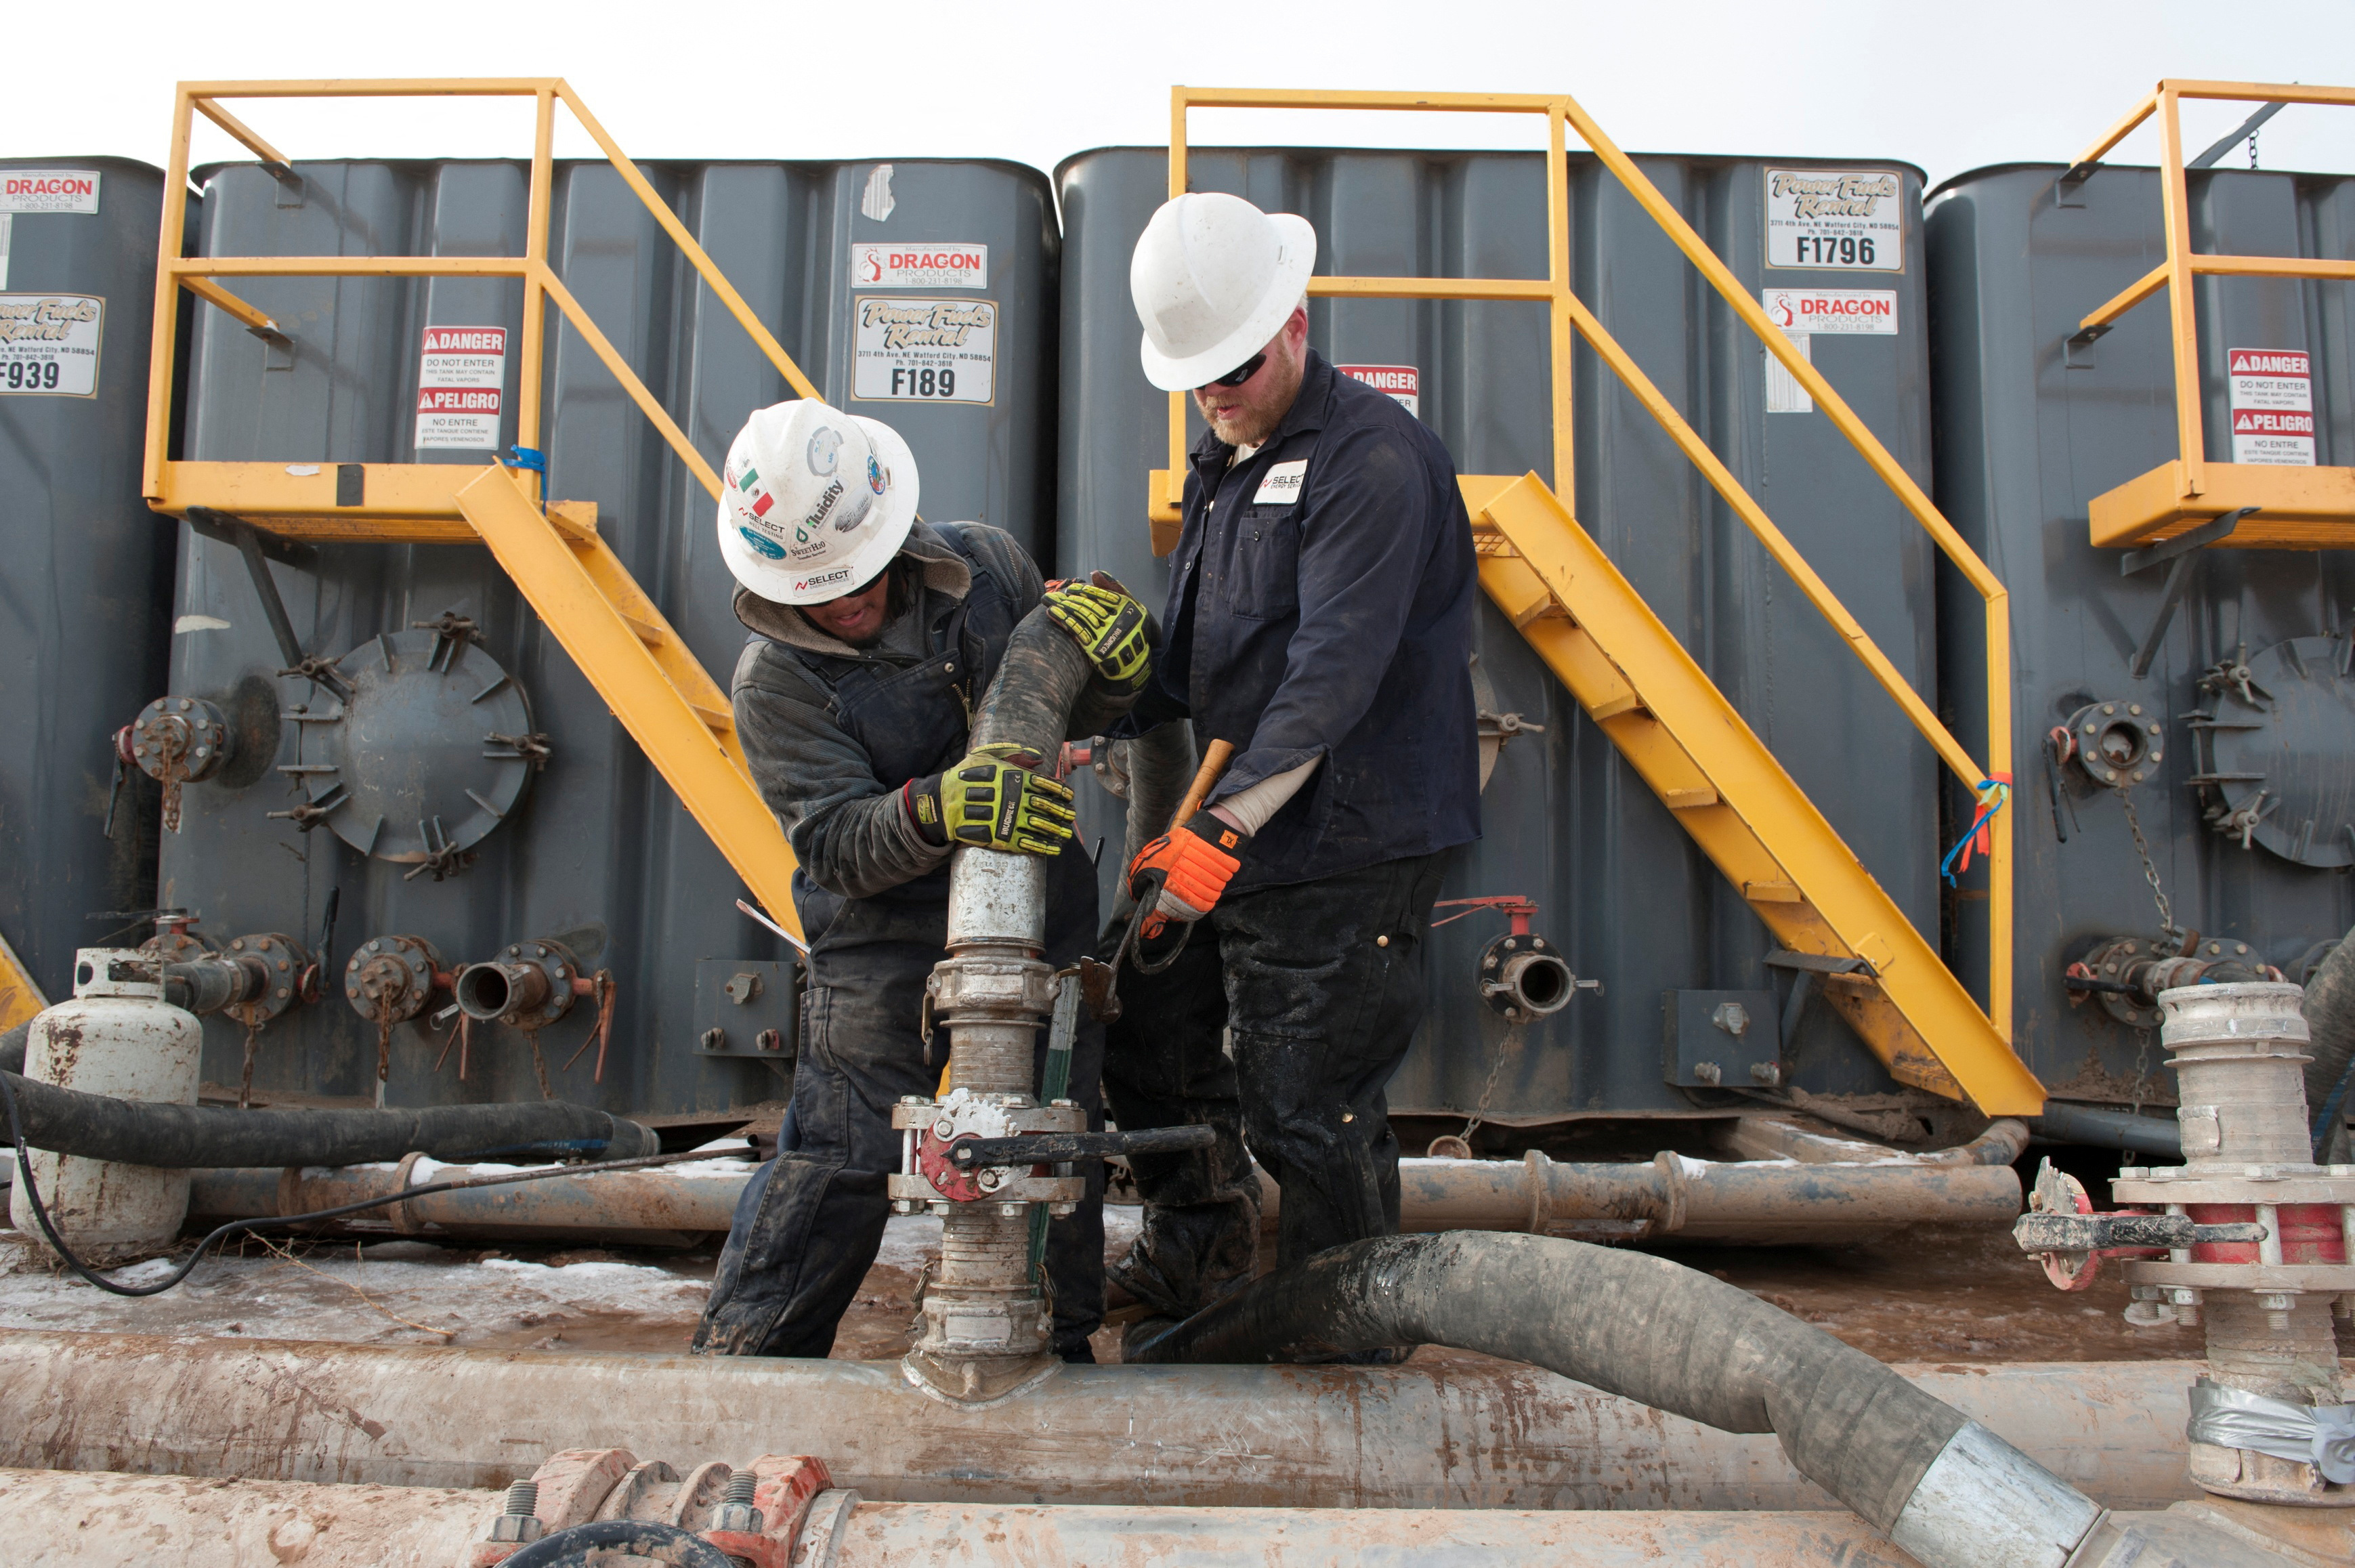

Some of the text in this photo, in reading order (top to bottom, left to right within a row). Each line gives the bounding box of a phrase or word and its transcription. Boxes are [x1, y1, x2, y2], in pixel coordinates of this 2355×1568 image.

[6, 179, 92, 195] DRAGON
[1772, 173, 1897, 200] Power Fuels
[12, 194, 83, 203] PRODUCTS
[1794, 194, 1877, 219] Rental
[1797, 236, 1875, 264] F1796
[889, 253, 980, 270] DRAGON
[897, 270, 971, 278] PRODUCTS
[35, 298, 97, 324] Fuels
[863, 301, 992, 329] Power Fuels
[1801, 299, 1890, 315] DRAGON
[1808, 315, 1882, 323] PRODUCTS
[0, 319, 72, 344] Rental
[884, 323, 970, 349] Rental
[440, 333, 503, 350] DANGER
[71, 347, 95, 356] 58854
[970, 354, 991, 362] 58854
[464, 359, 494, 367] ENTER
[2250, 356, 2309, 374] DANGER
[891, 368, 955, 397] F189
[2277, 382, 2306, 390] ENTER
[434, 392, 499, 409] PELIGRO
[2253, 414, 2312, 432] PELIGRO
[805, 480, 844, 529] fluidity
[748, 512, 785, 533] SELECT
[748, 520, 784, 540] WELL TESTING
[808, 570, 849, 586] SELECT
[1001, 801, 1016, 836] ROUGHNECK
